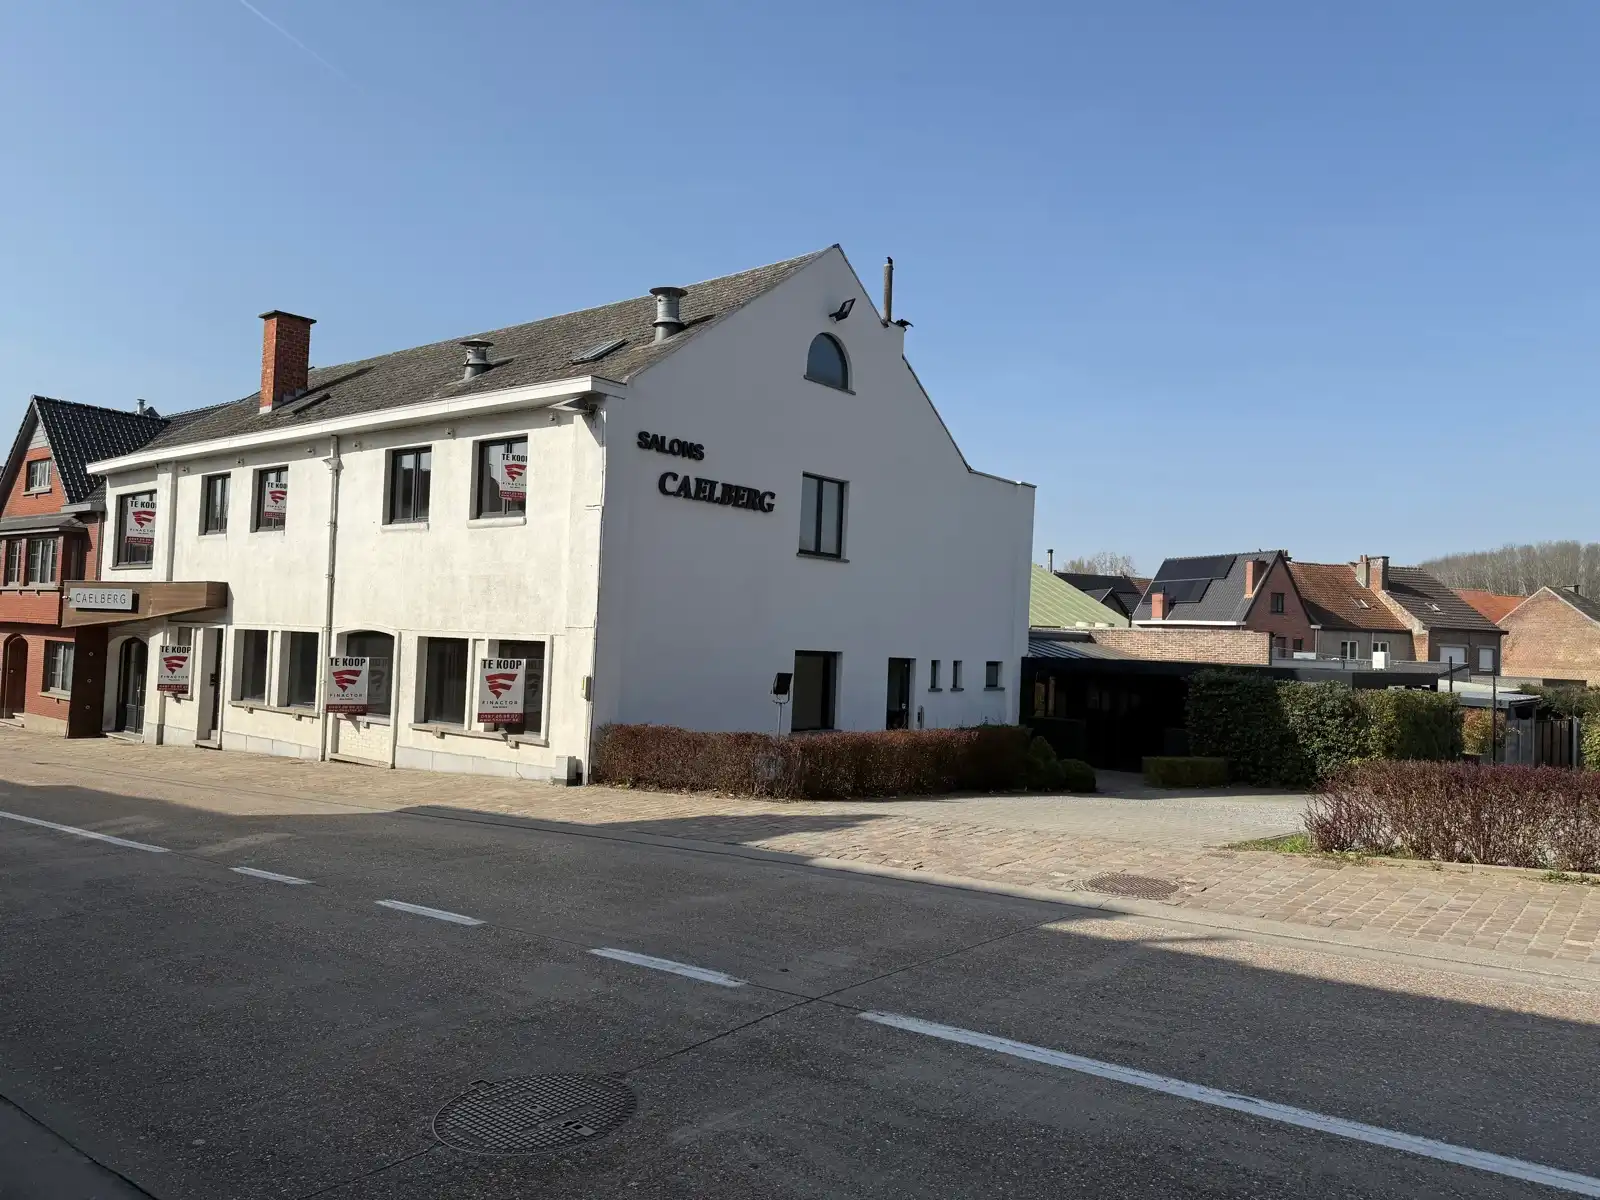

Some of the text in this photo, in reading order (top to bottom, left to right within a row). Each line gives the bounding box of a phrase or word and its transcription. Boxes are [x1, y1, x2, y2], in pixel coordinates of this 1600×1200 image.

[636, 430, 705, 461] SALONS
[502, 453, 510, 461] TE
[658, 471, 777, 513] CAELBERG
[130, 500, 156, 509] TE KOO
[75, 592, 126, 605] CAELBERG
[160, 645, 191, 654] TE KOOP
[329, 657, 340, 667] TE
[342, 657, 366, 667] KOOP
[482, 659, 494, 669] TE
[496, 659, 522, 670] KOOP
